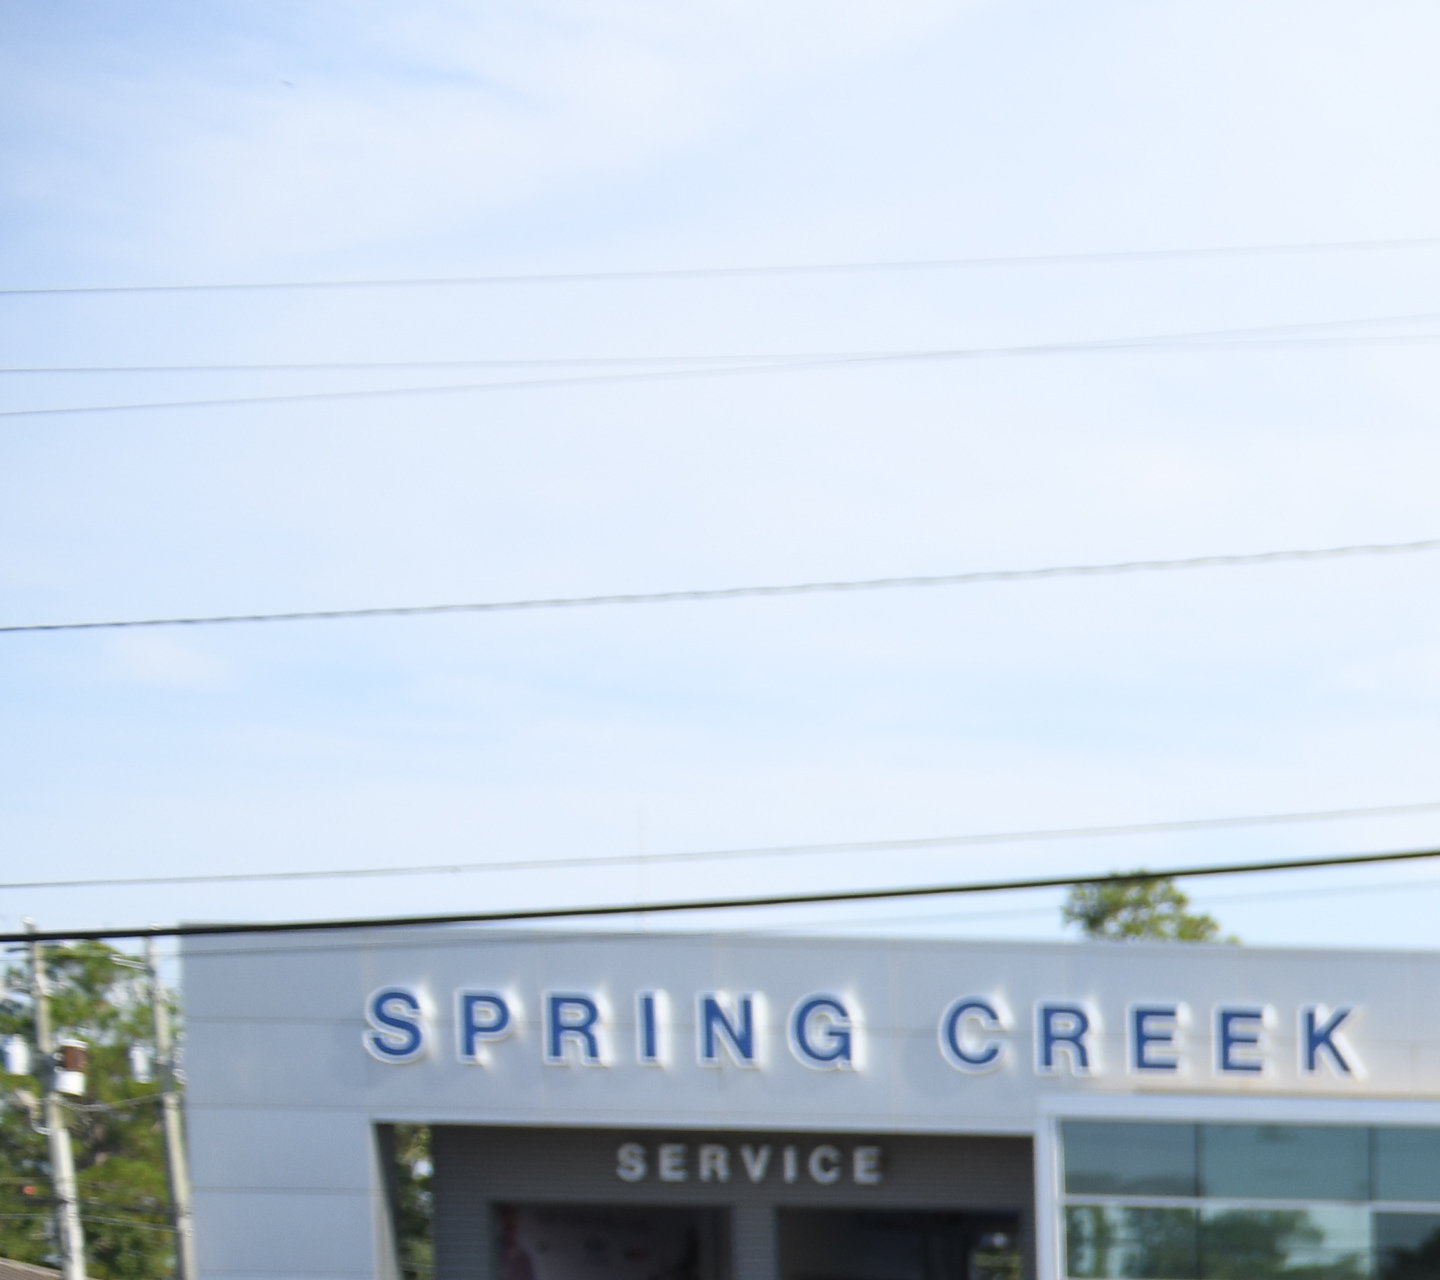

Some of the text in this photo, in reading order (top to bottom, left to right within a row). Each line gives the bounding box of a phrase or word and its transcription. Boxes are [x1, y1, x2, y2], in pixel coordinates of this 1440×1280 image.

[366, 987, 1358, 1076] SPRING CREEK
[615, 1142, 885, 1186] SERVICE
